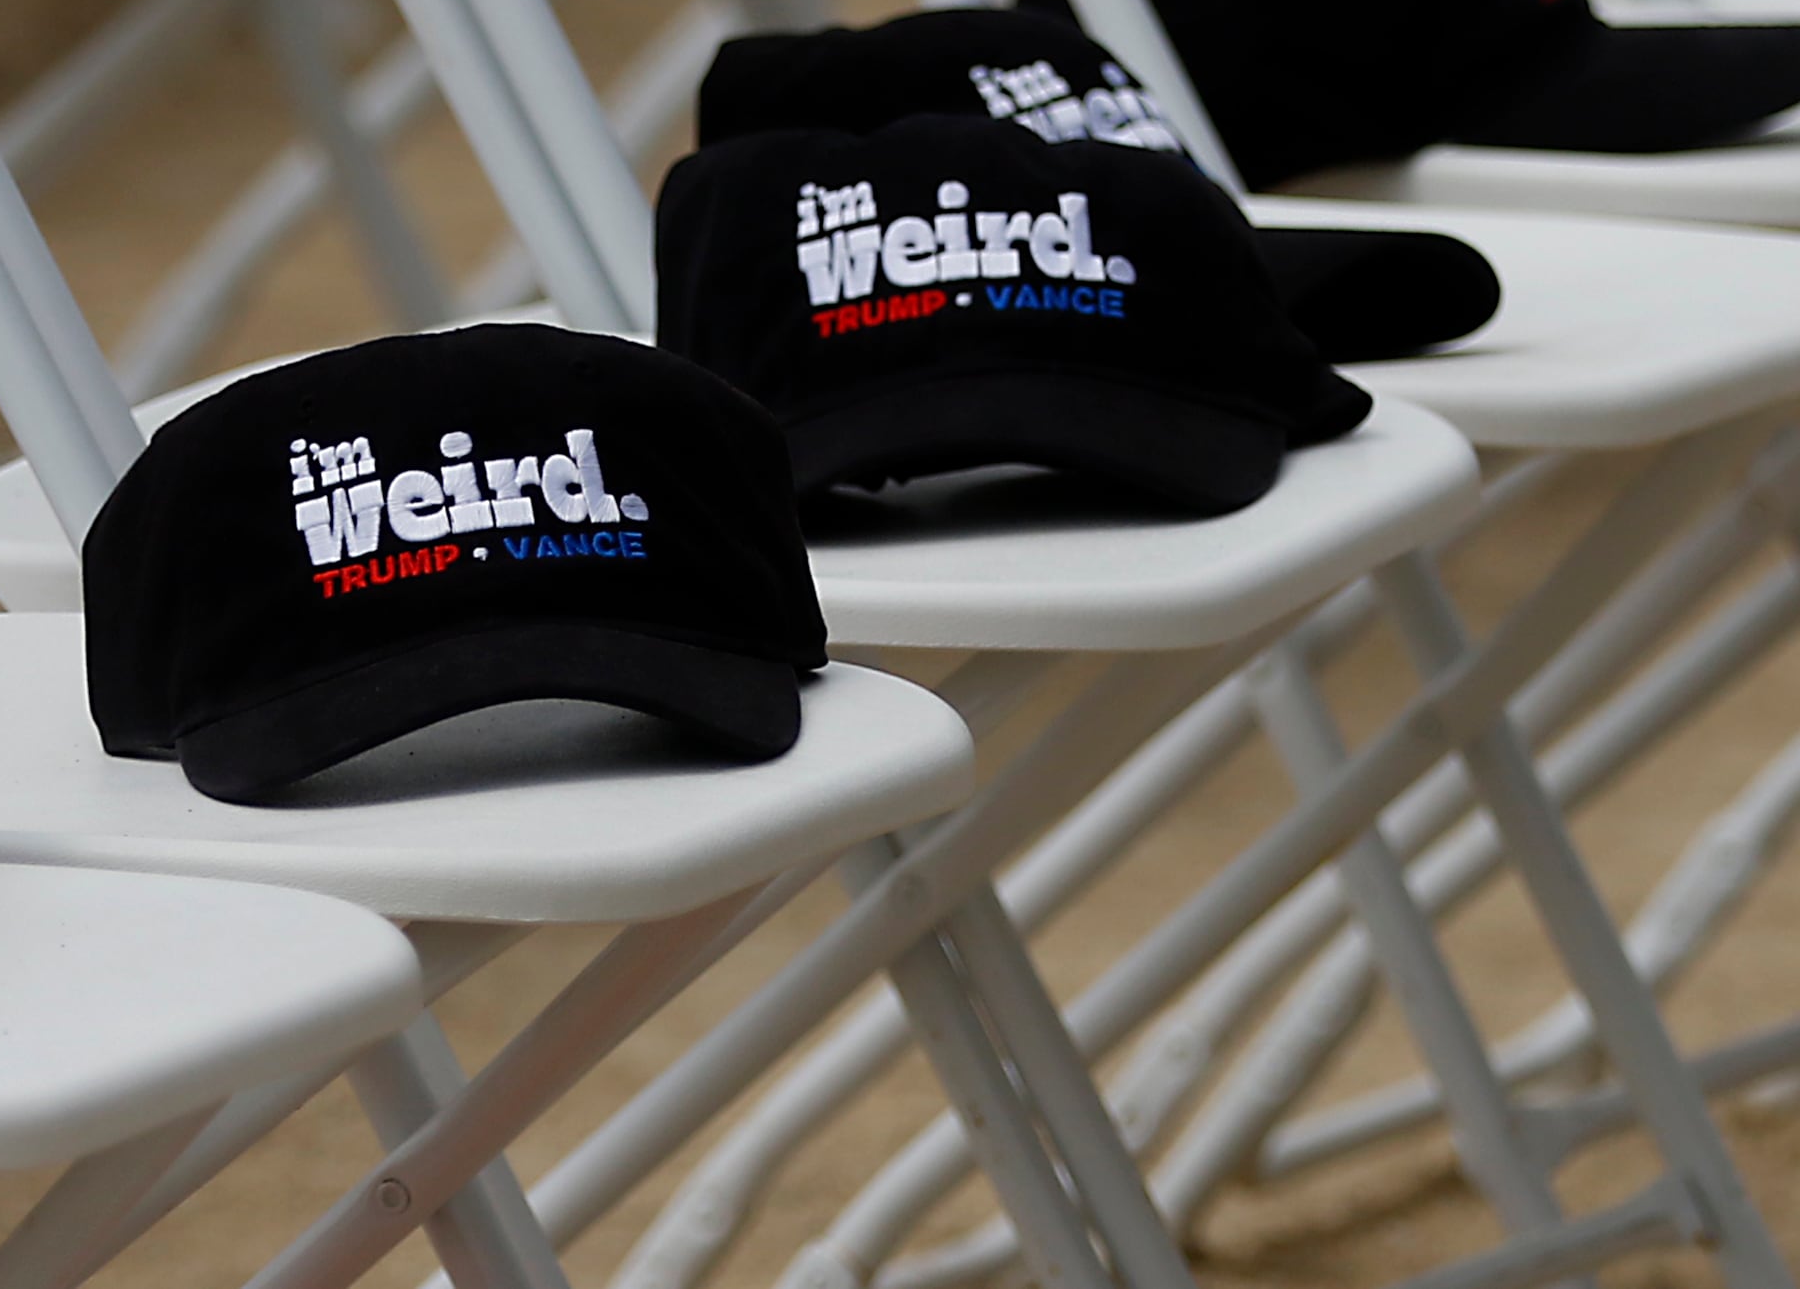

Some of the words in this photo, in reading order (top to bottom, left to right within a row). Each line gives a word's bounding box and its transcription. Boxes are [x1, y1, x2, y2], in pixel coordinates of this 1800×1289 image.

[797, 181, 877, 238] i'm
[812, 289, 947, 339] TRUMP
[985, 284, 1126, 318] VANCE
[290, 437, 375, 495] i'm
[313, 543, 460, 599] TRUMP
[504, 532, 648, 560] VANCE
